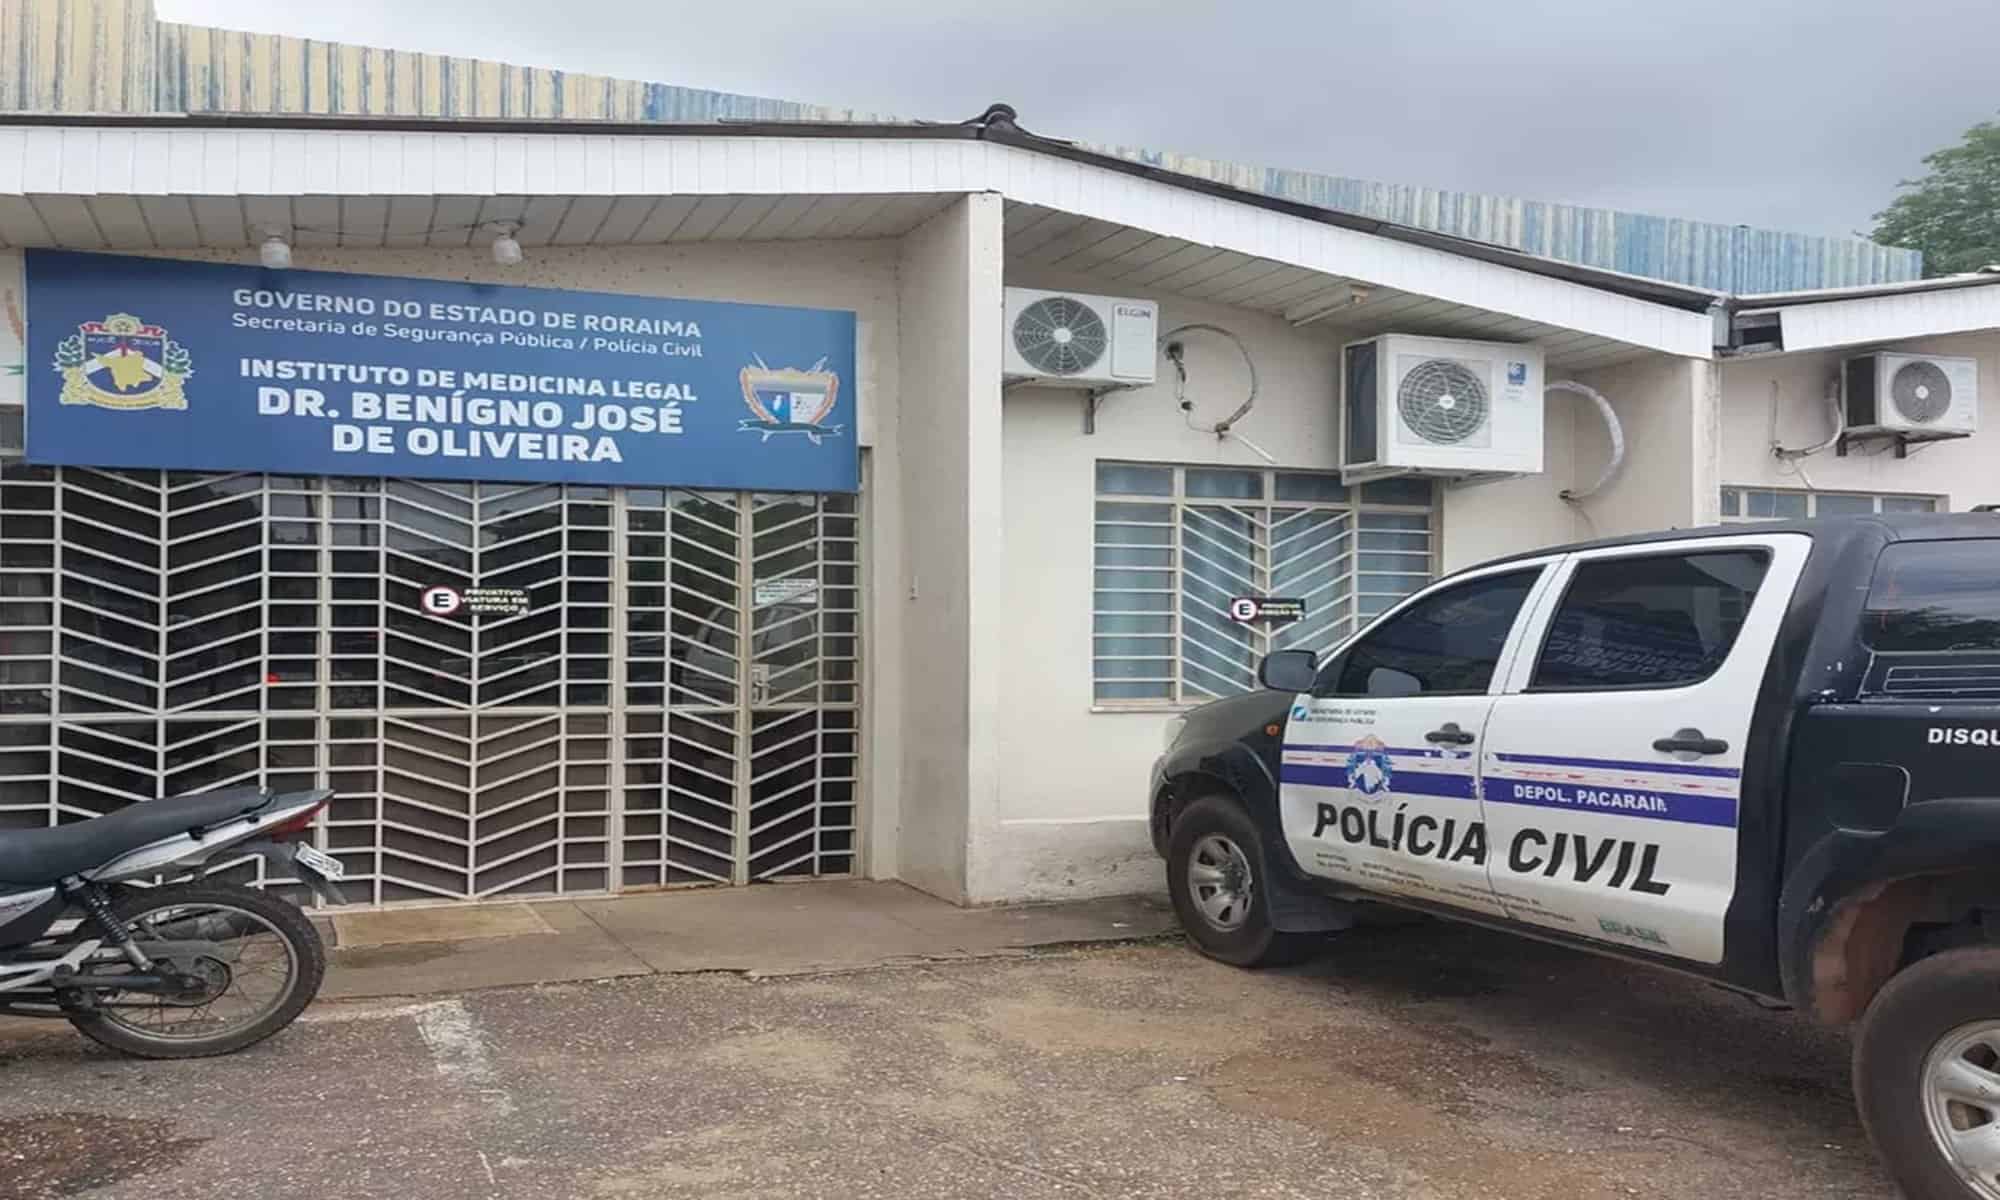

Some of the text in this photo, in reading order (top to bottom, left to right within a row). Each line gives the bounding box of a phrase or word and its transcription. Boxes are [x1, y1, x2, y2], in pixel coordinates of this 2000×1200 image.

[232, 288, 702, 338] GOVERNO DO ESTADO DE RORAIMA
[232, 312, 703, 358] Secretaria de Segurança Pública / Polícia Civil
[240, 358, 698, 401] INSTITUTO DE MEDICINA LEGAL
[257, 386, 684, 434] DR. BENÍGNO JOSÉ
[332, 424, 623, 463] DE OLIVEIRA
[433, 593, 450, 607] E
[1513, 784, 1572, 803] DEPOL.
[1312, 802, 1487, 866] POLÍCIA
[1508, 828, 1672, 897] CIVIL
